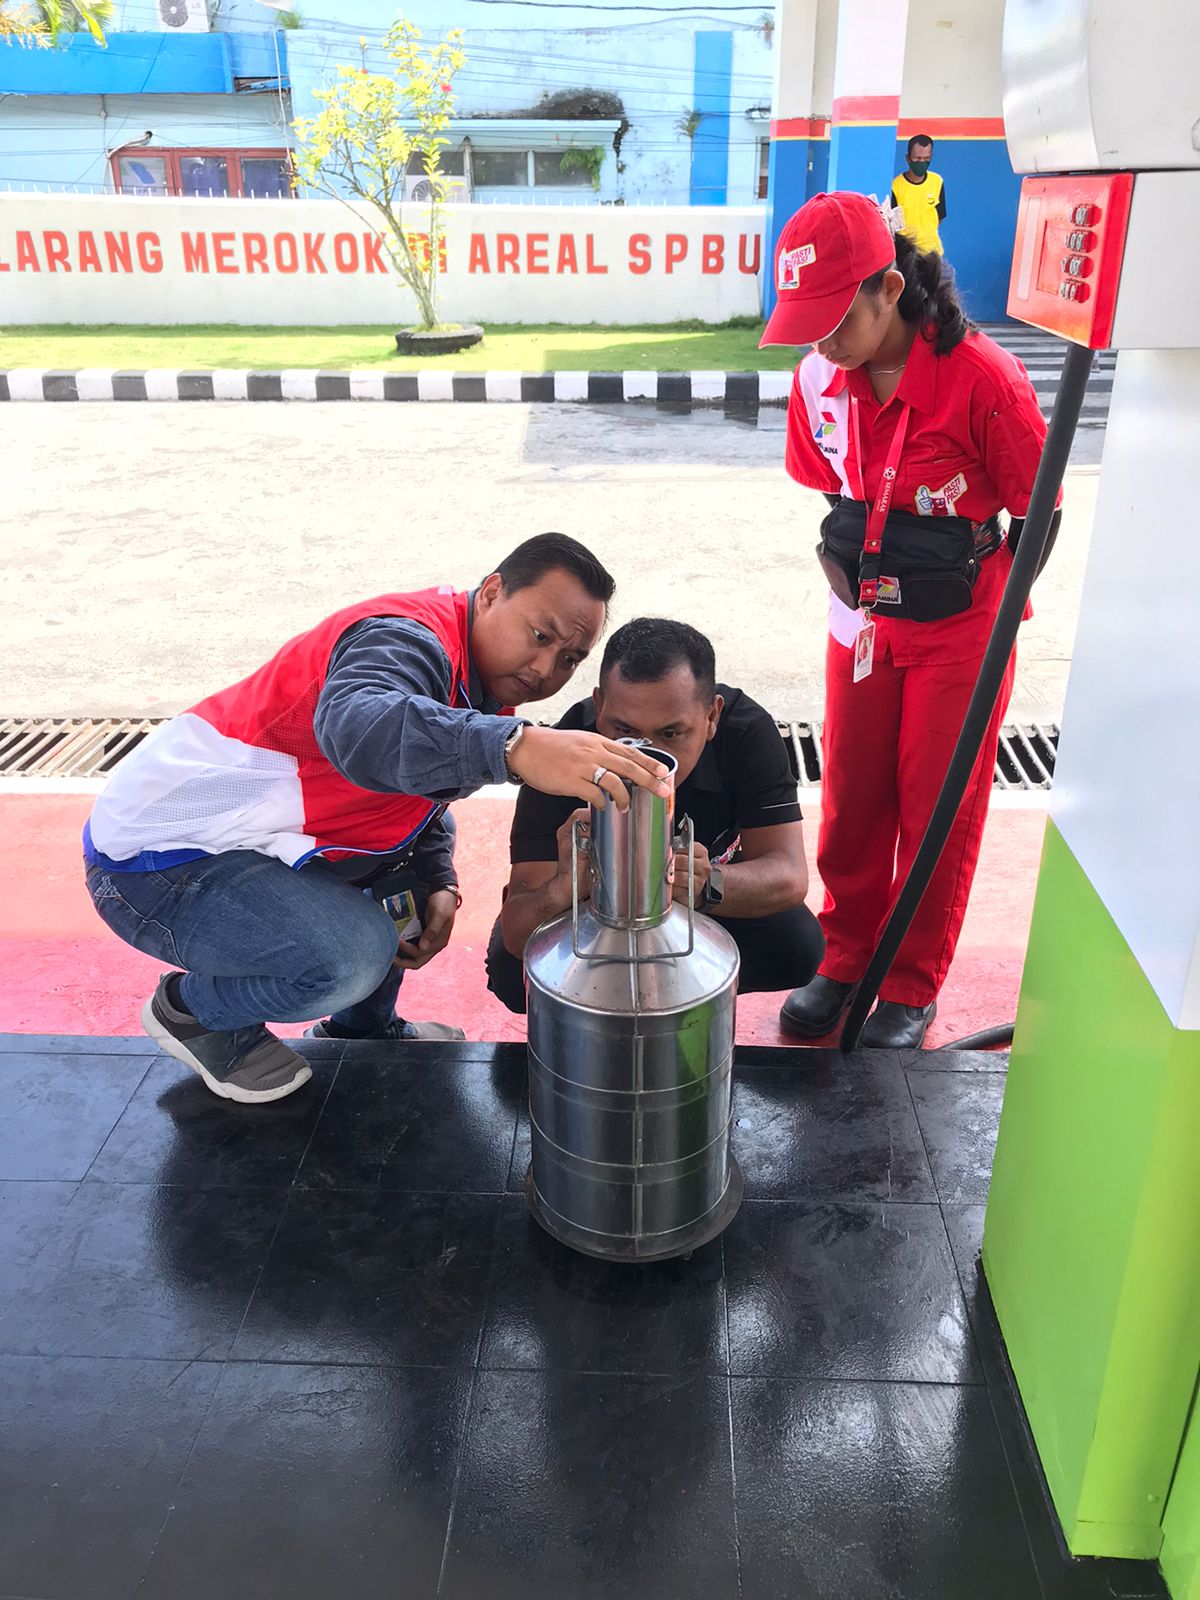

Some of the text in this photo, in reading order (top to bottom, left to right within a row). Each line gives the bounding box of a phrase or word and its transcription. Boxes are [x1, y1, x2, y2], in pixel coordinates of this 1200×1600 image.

[181, 231, 390, 274] MEROKOK
[468, 233, 608, 273] AREAL
[628, 233, 760, 275] SPBU
